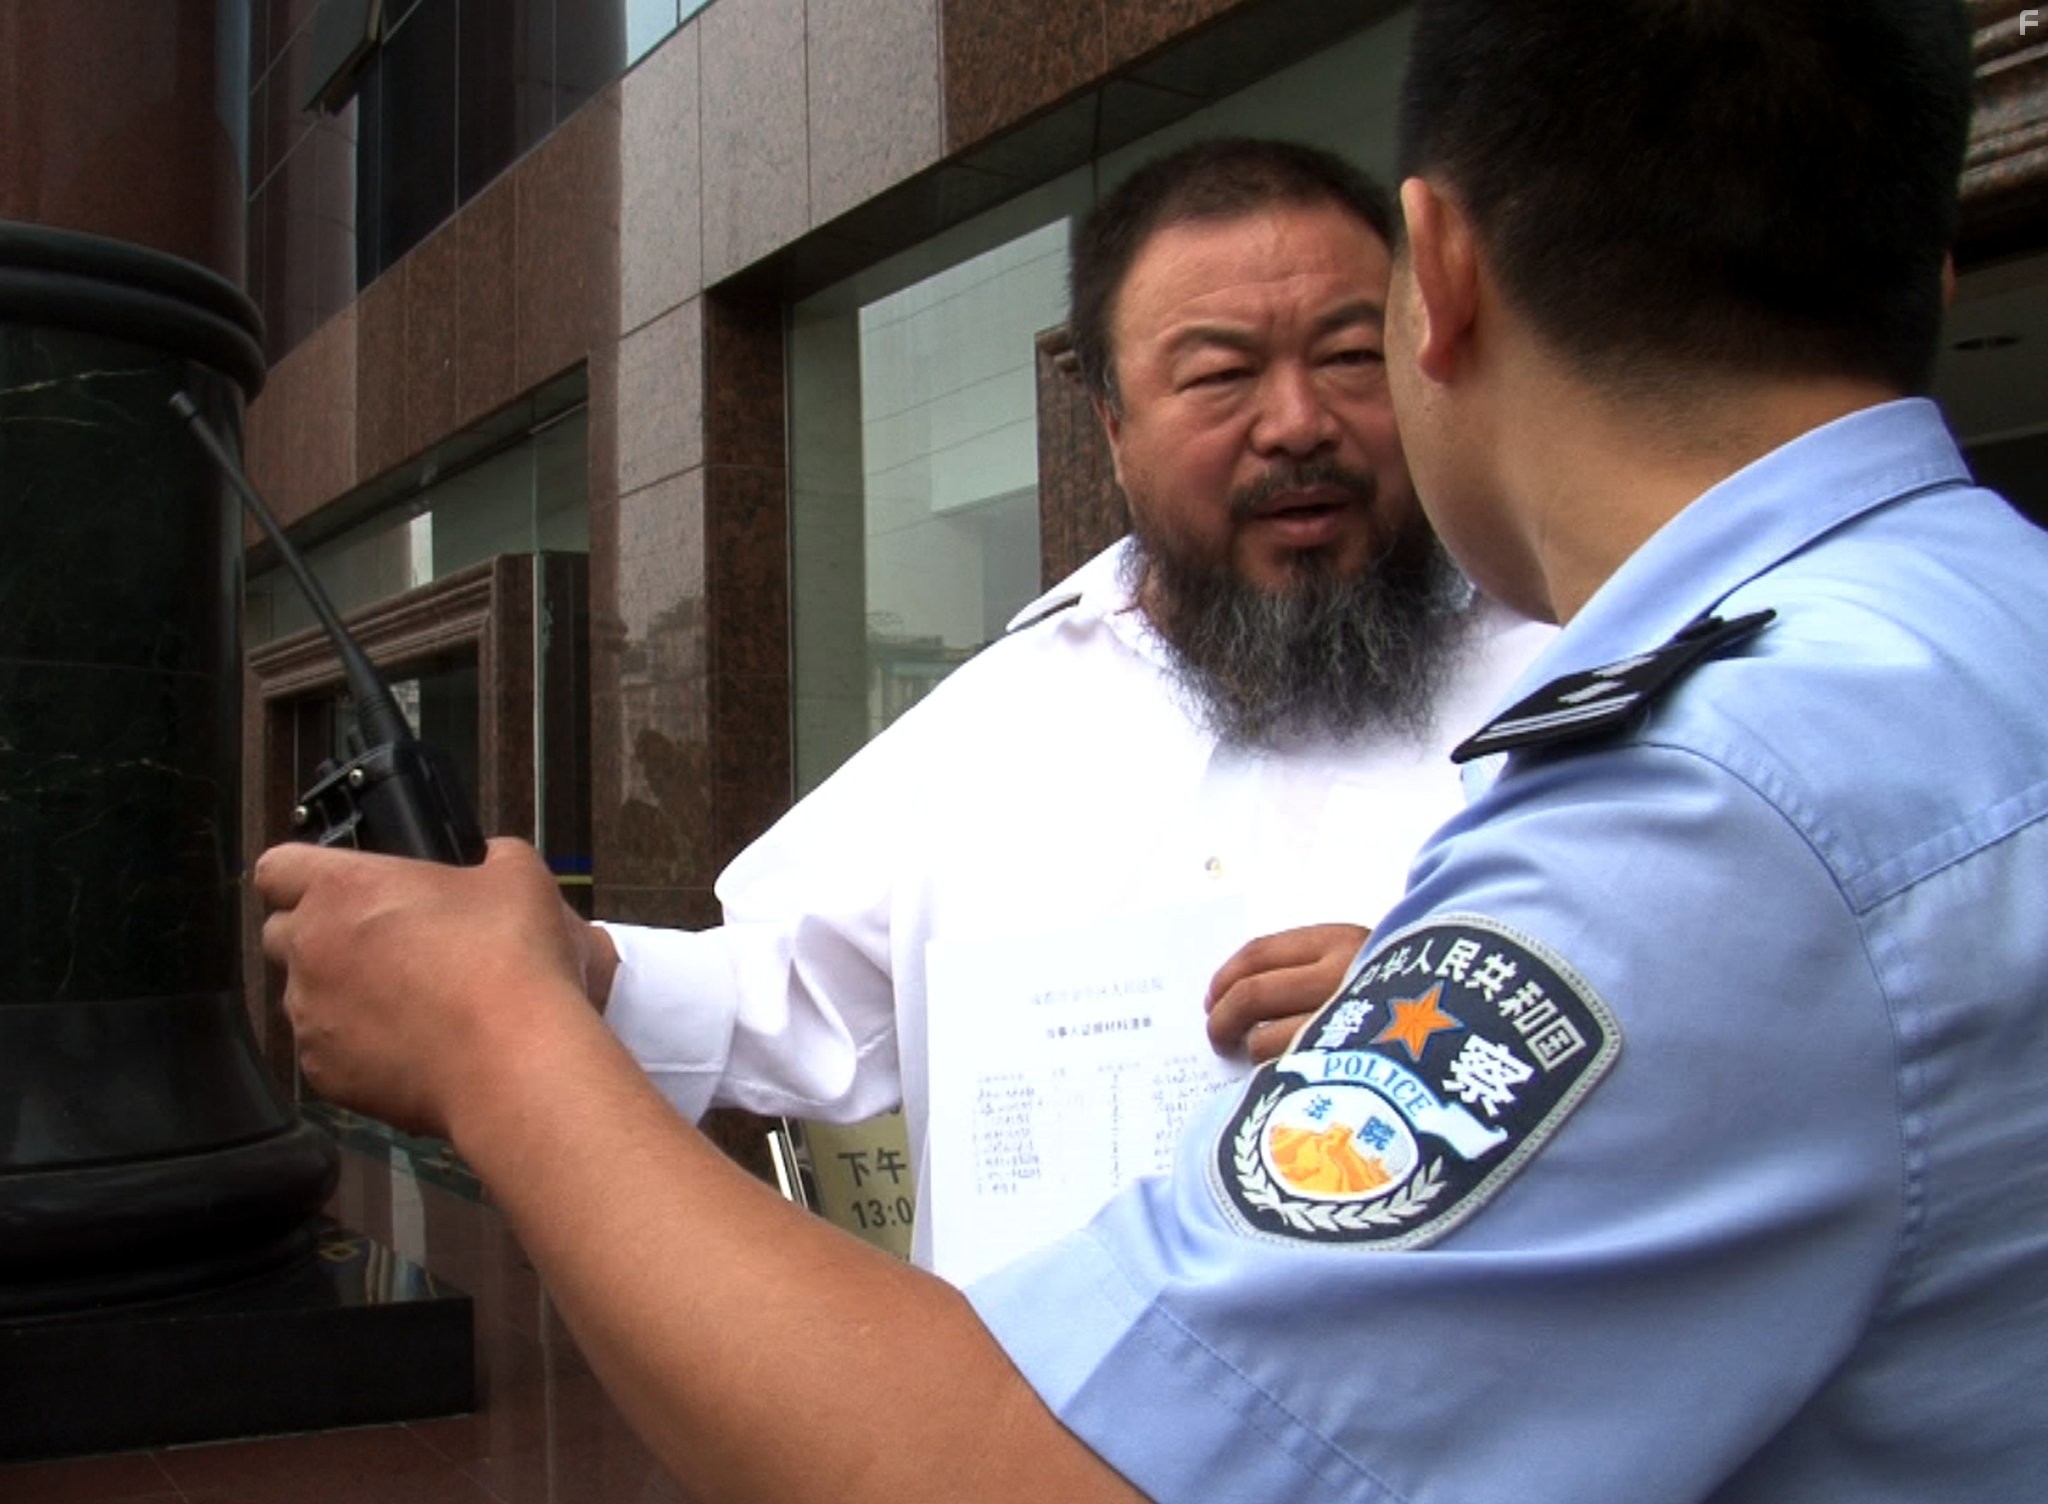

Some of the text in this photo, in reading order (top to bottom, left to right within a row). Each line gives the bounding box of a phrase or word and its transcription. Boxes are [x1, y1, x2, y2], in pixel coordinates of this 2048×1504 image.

[1349, 938, 1586, 1071] 中华人民共和国
[1322, 1055, 1434, 1118] POLICE
[838, 1147, 907, 1187] 下午
